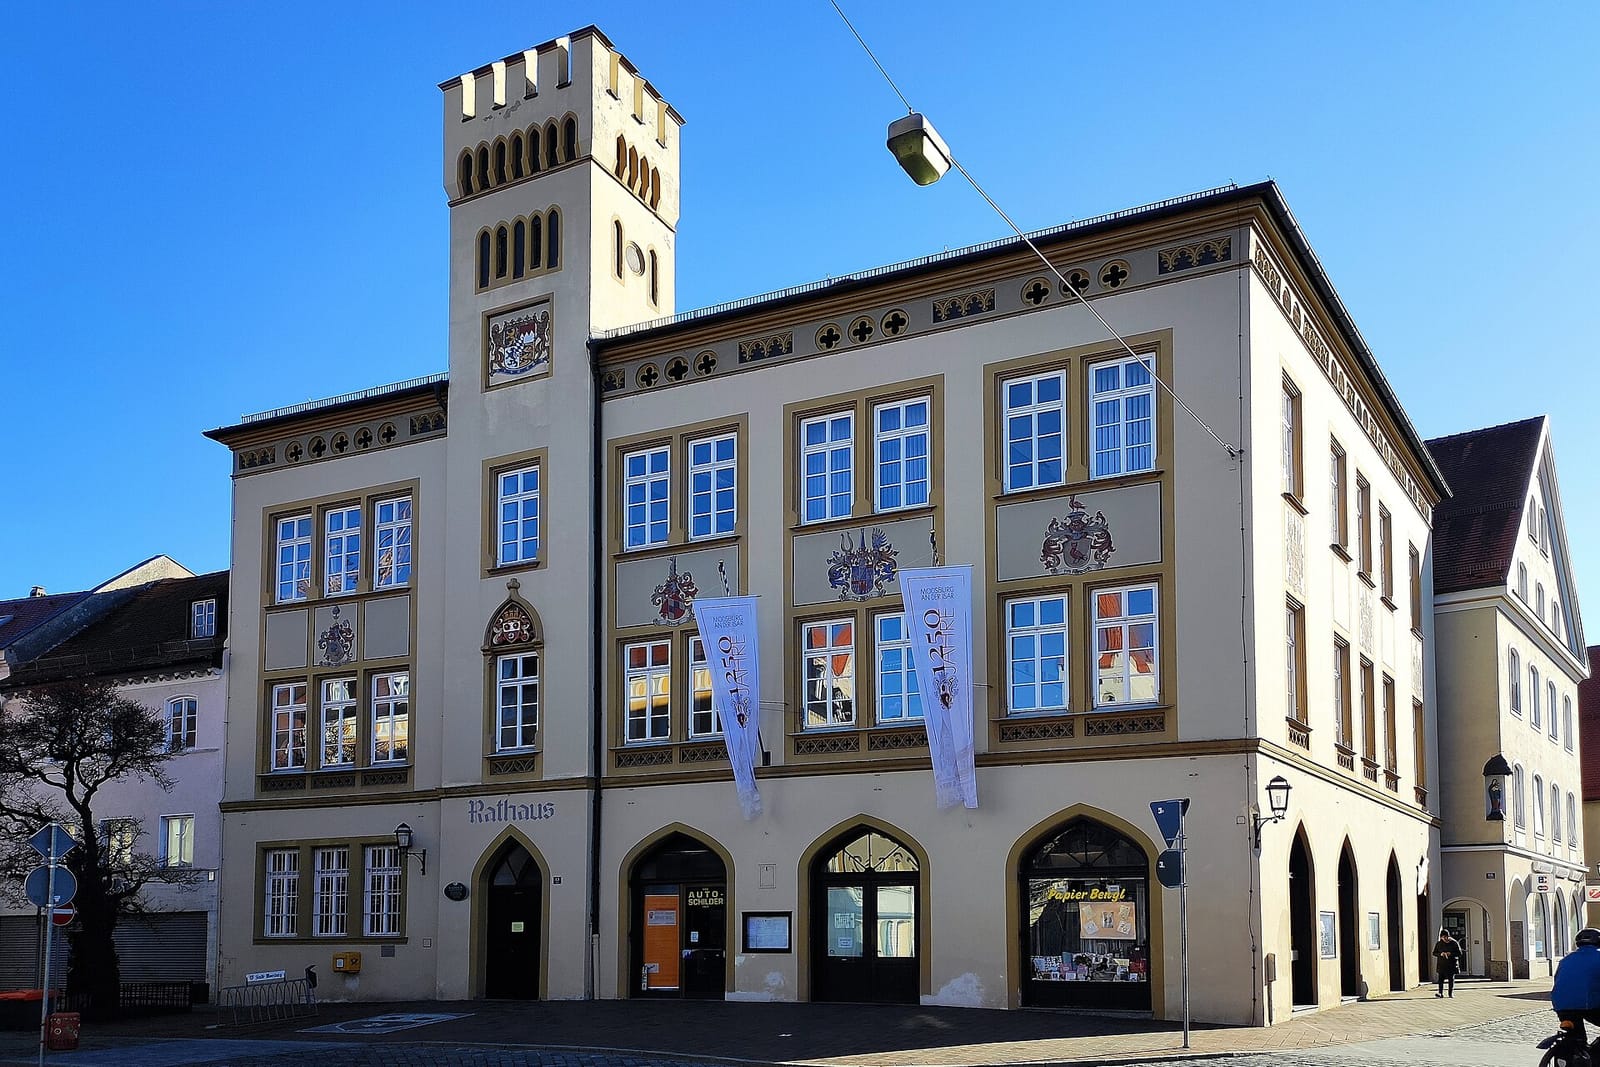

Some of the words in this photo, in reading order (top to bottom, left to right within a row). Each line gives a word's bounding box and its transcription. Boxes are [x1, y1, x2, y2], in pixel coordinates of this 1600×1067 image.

[923, 609, 945, 676] 1250
[718, 636, 738, 697] 1250
[467, 799, 555, 823] Rathaus
[688, 897, 724, 906] SCHILDER
[1047, 889, 1088, 902] Papier
[1089, 888, 1126, 902] Bengl
